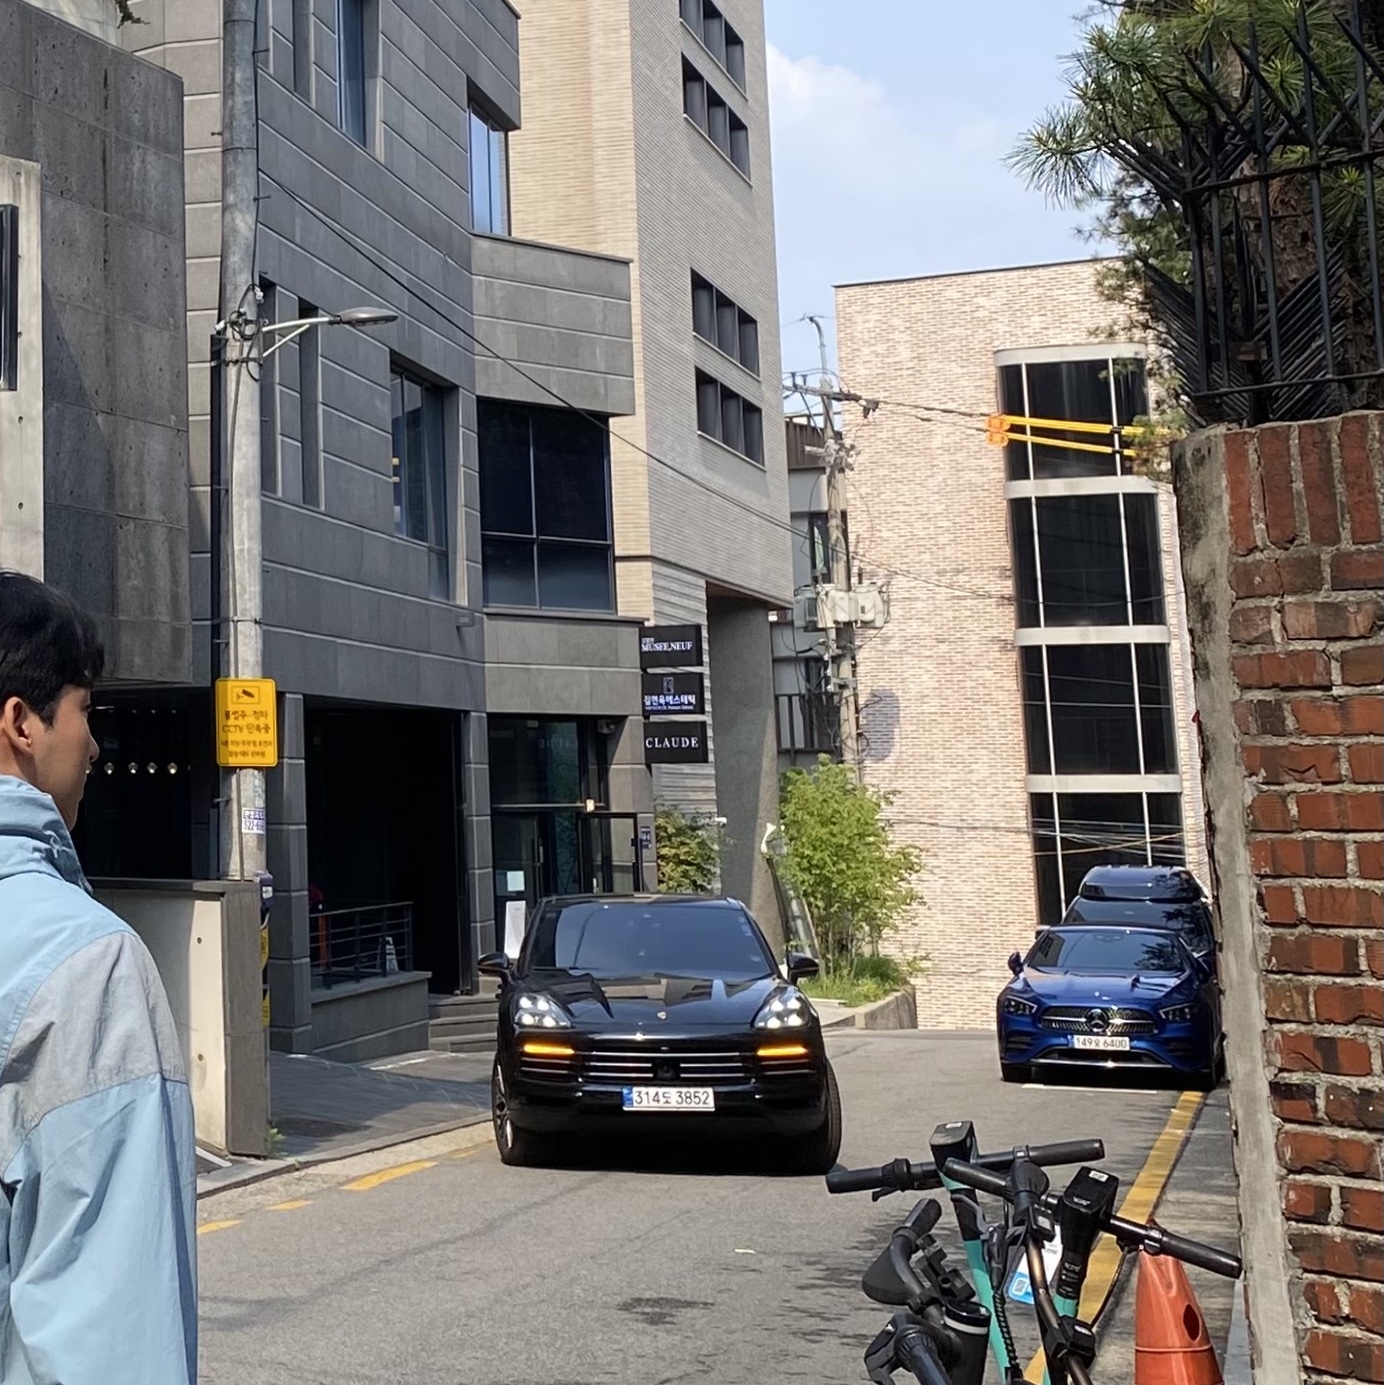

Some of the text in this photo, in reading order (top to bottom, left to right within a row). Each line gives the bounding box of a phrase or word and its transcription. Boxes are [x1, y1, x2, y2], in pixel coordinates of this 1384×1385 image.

[221, 724, 244, 734] CCTV
[645, 736, 699, 749] CLAUDE
[1102, 1038, 1128, 1049] 6400
[635, 1090, 710, 1106] 314도 3852
